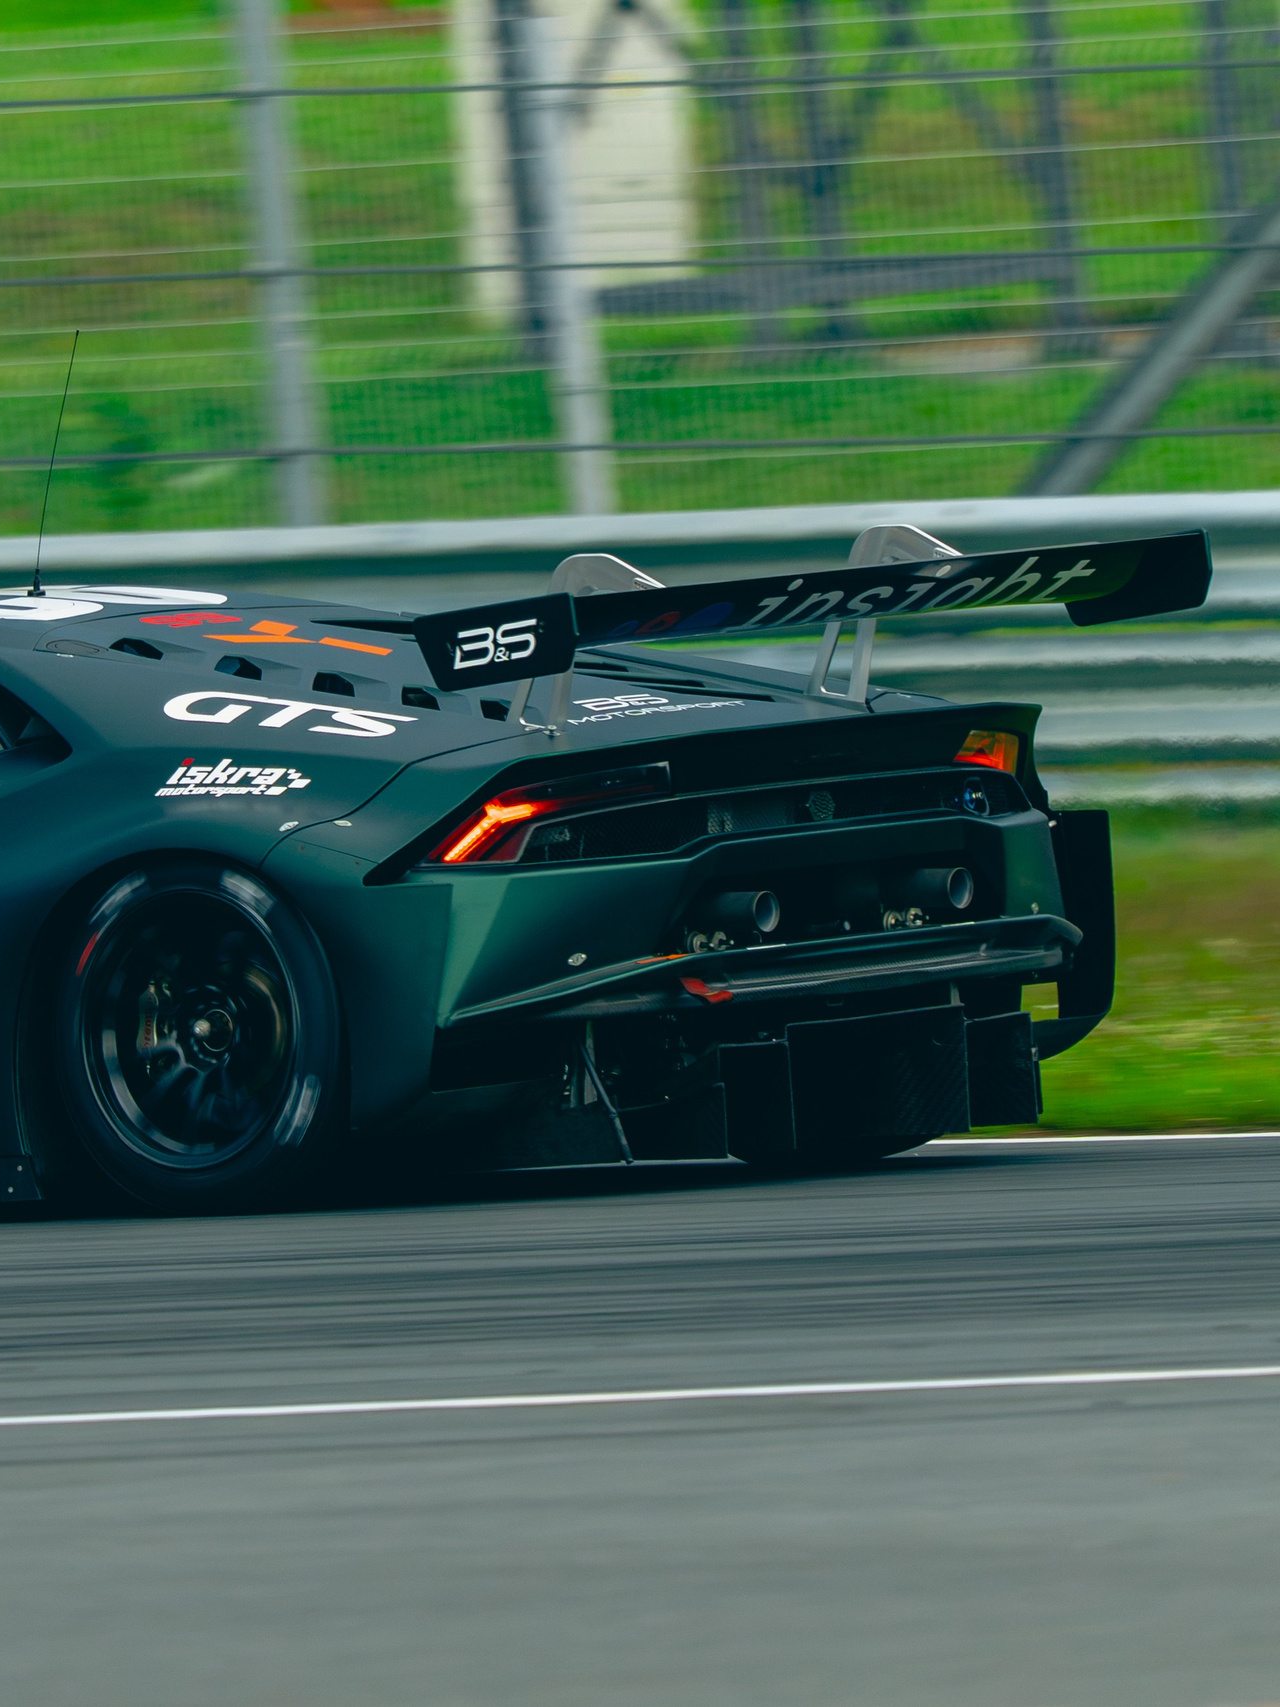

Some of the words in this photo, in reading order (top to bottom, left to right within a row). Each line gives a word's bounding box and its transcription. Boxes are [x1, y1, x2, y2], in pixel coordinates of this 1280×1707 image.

[452, 618, 538, 671] B&S
[163, 690, 418, 738] GTS
[567, 700, 746, 726] MOTORSPORT
[166, 758, 287, 785] iskra
[154, 784, 267, 797] motorsport
